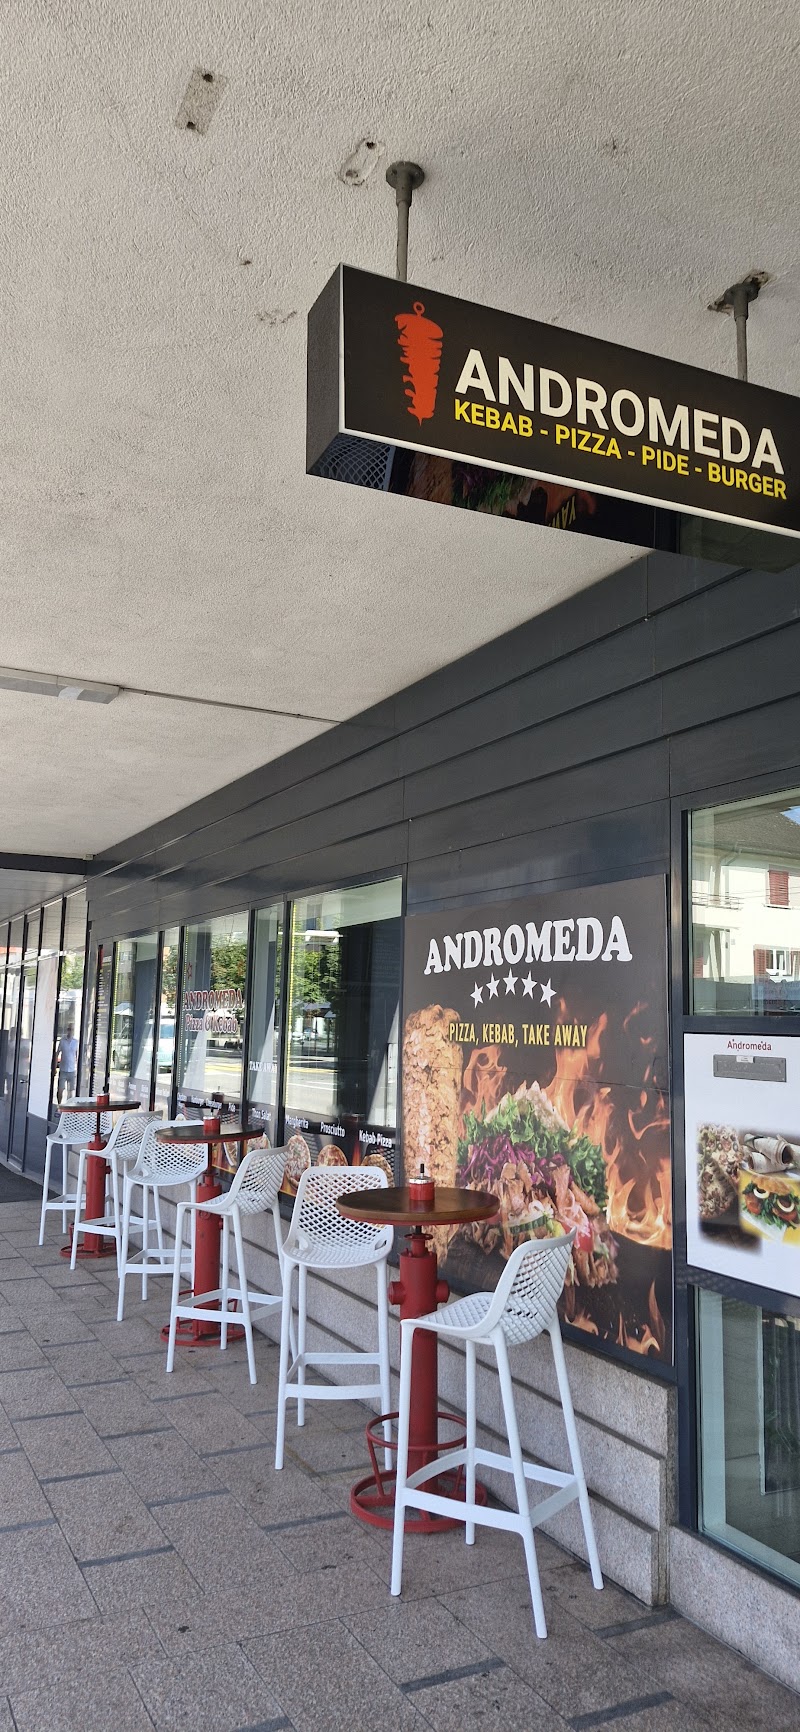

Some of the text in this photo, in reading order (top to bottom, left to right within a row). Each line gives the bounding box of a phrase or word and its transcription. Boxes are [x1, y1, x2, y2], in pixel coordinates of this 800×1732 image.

[455, 348, 785, 475] ANDROMEDA
[454, 398, 534, 438] KEBAB
[555, 424, 622, 460] PIZZA
[642, 445, 689, 477] PIDE
[708, 462, 788, 500] BURGER
[423, 915, 633, 975] ANDROMEDA
[183, 988, 243, 1010] ANDROMEDA
[184, 1013, 203, 1032] Pizza
[211, 1014, 239, 1034] Kebab
[448, 1022, 589, 1048] PIZZA, KEBAB, TAKE AWAY
[727, 1040, 772, 1051] Andromeda
[285, 1114, 309, 1129] Margherita
[320, 1121, 346, 1138] Prosciutto
